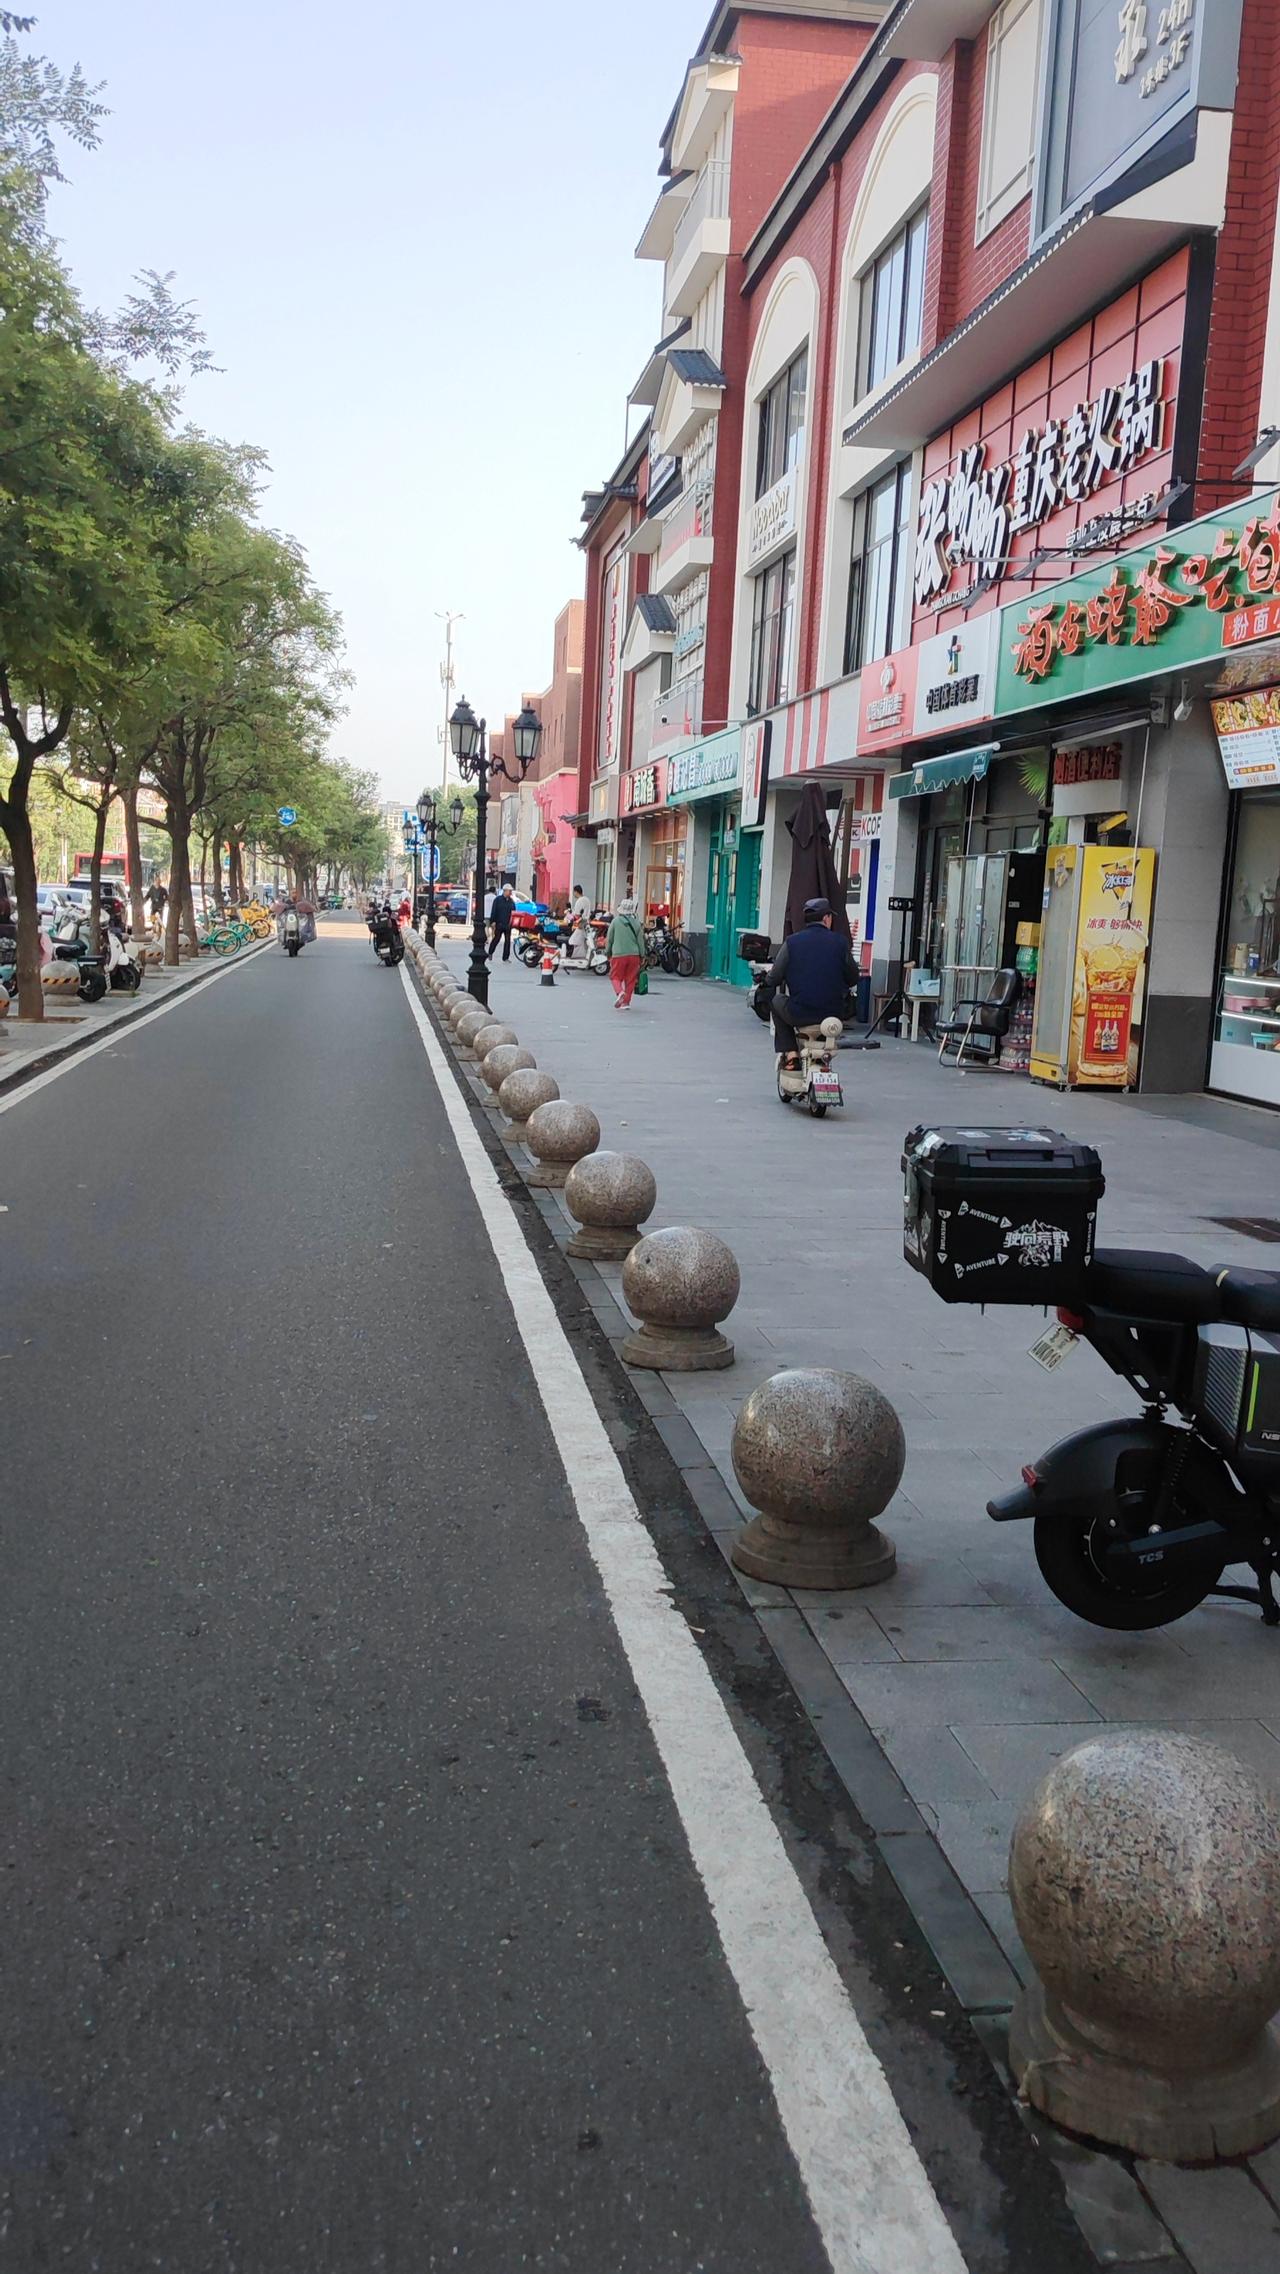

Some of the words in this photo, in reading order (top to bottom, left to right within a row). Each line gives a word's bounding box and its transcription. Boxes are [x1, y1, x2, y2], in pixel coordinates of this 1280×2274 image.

[925, 673, 980, 714] 中国体育彩票
[1054, 743, 1121, 785] 烟酒便利店
[969, 1208, 1000, 1224] AVENTURE
[939, 1219, 947, 1251] AVENTURE
[1003, 1231, 1070, 1249] 驶向荒野
[965, 1257, 997, 1273] AVENTURE
[1139, 1551, 1164, 1565] TCS
